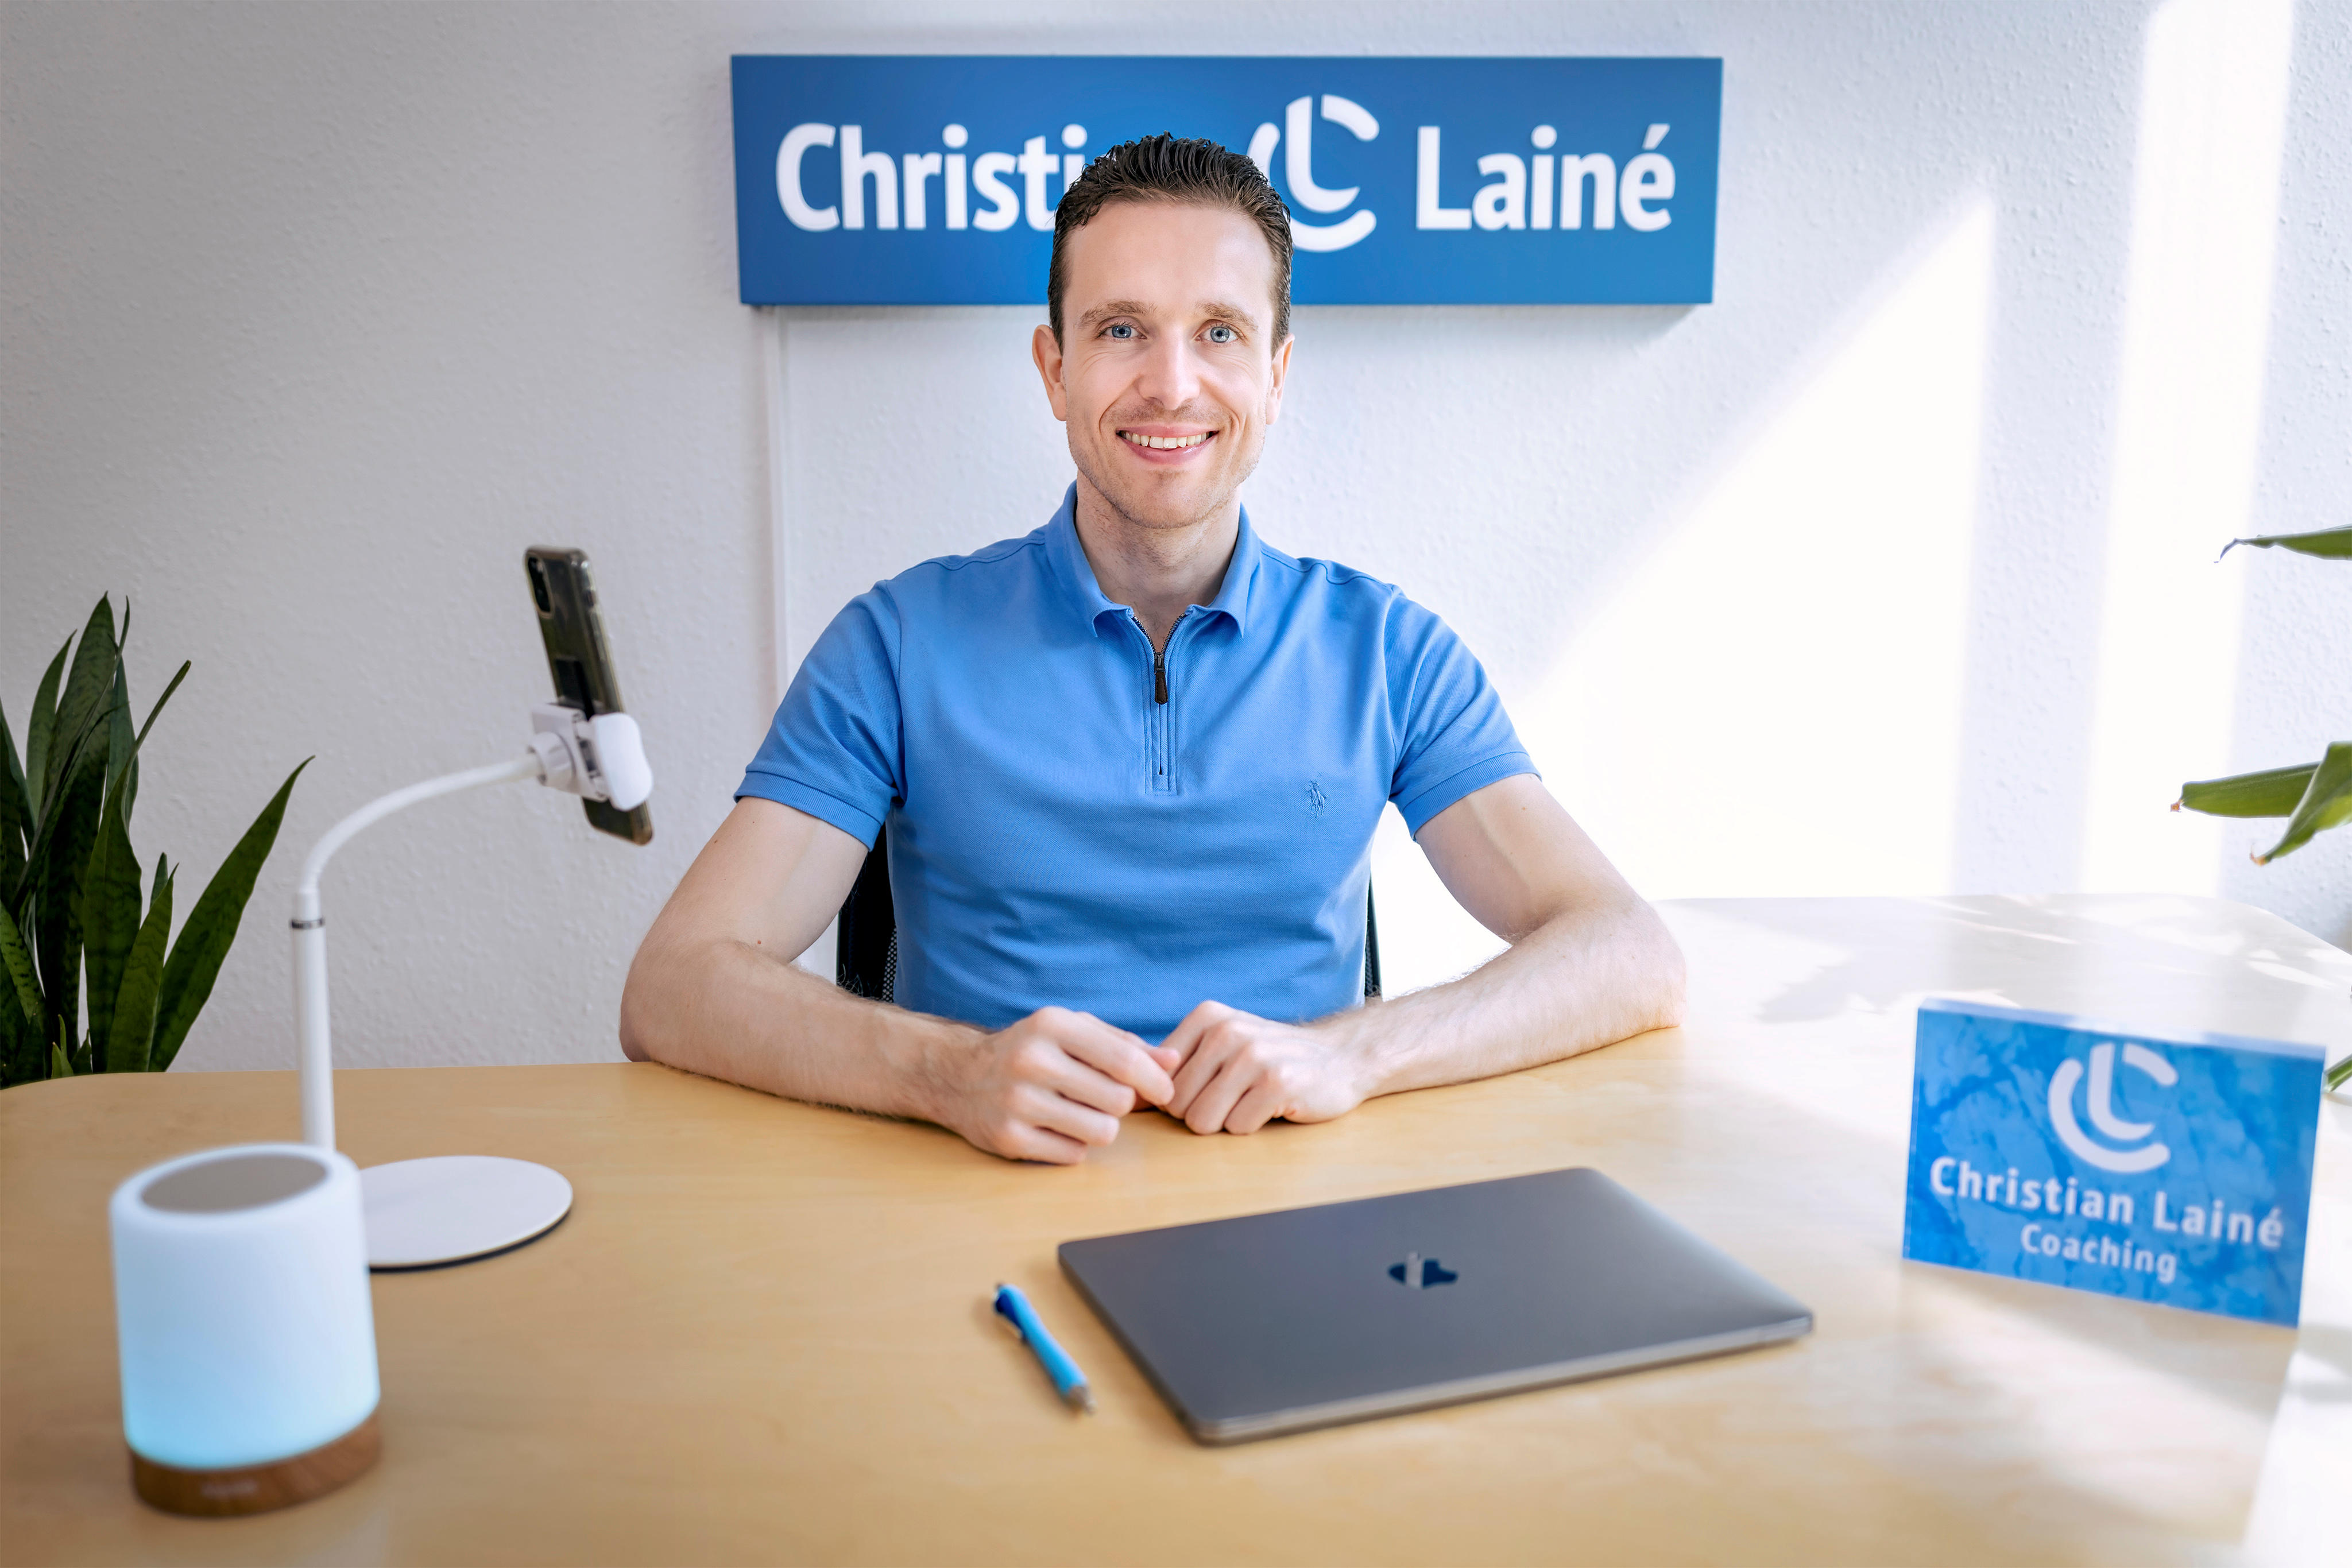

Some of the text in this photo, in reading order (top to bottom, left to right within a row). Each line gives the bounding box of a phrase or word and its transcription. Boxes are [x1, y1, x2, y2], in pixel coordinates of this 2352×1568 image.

[776, 123, 1088, 231] Christi
[1417, 123, 1676, 232] Lainé
[1930, 1156, 2284, 1248] Christian Lainé
[2021, 1224, 2177, 1284] Coaching
